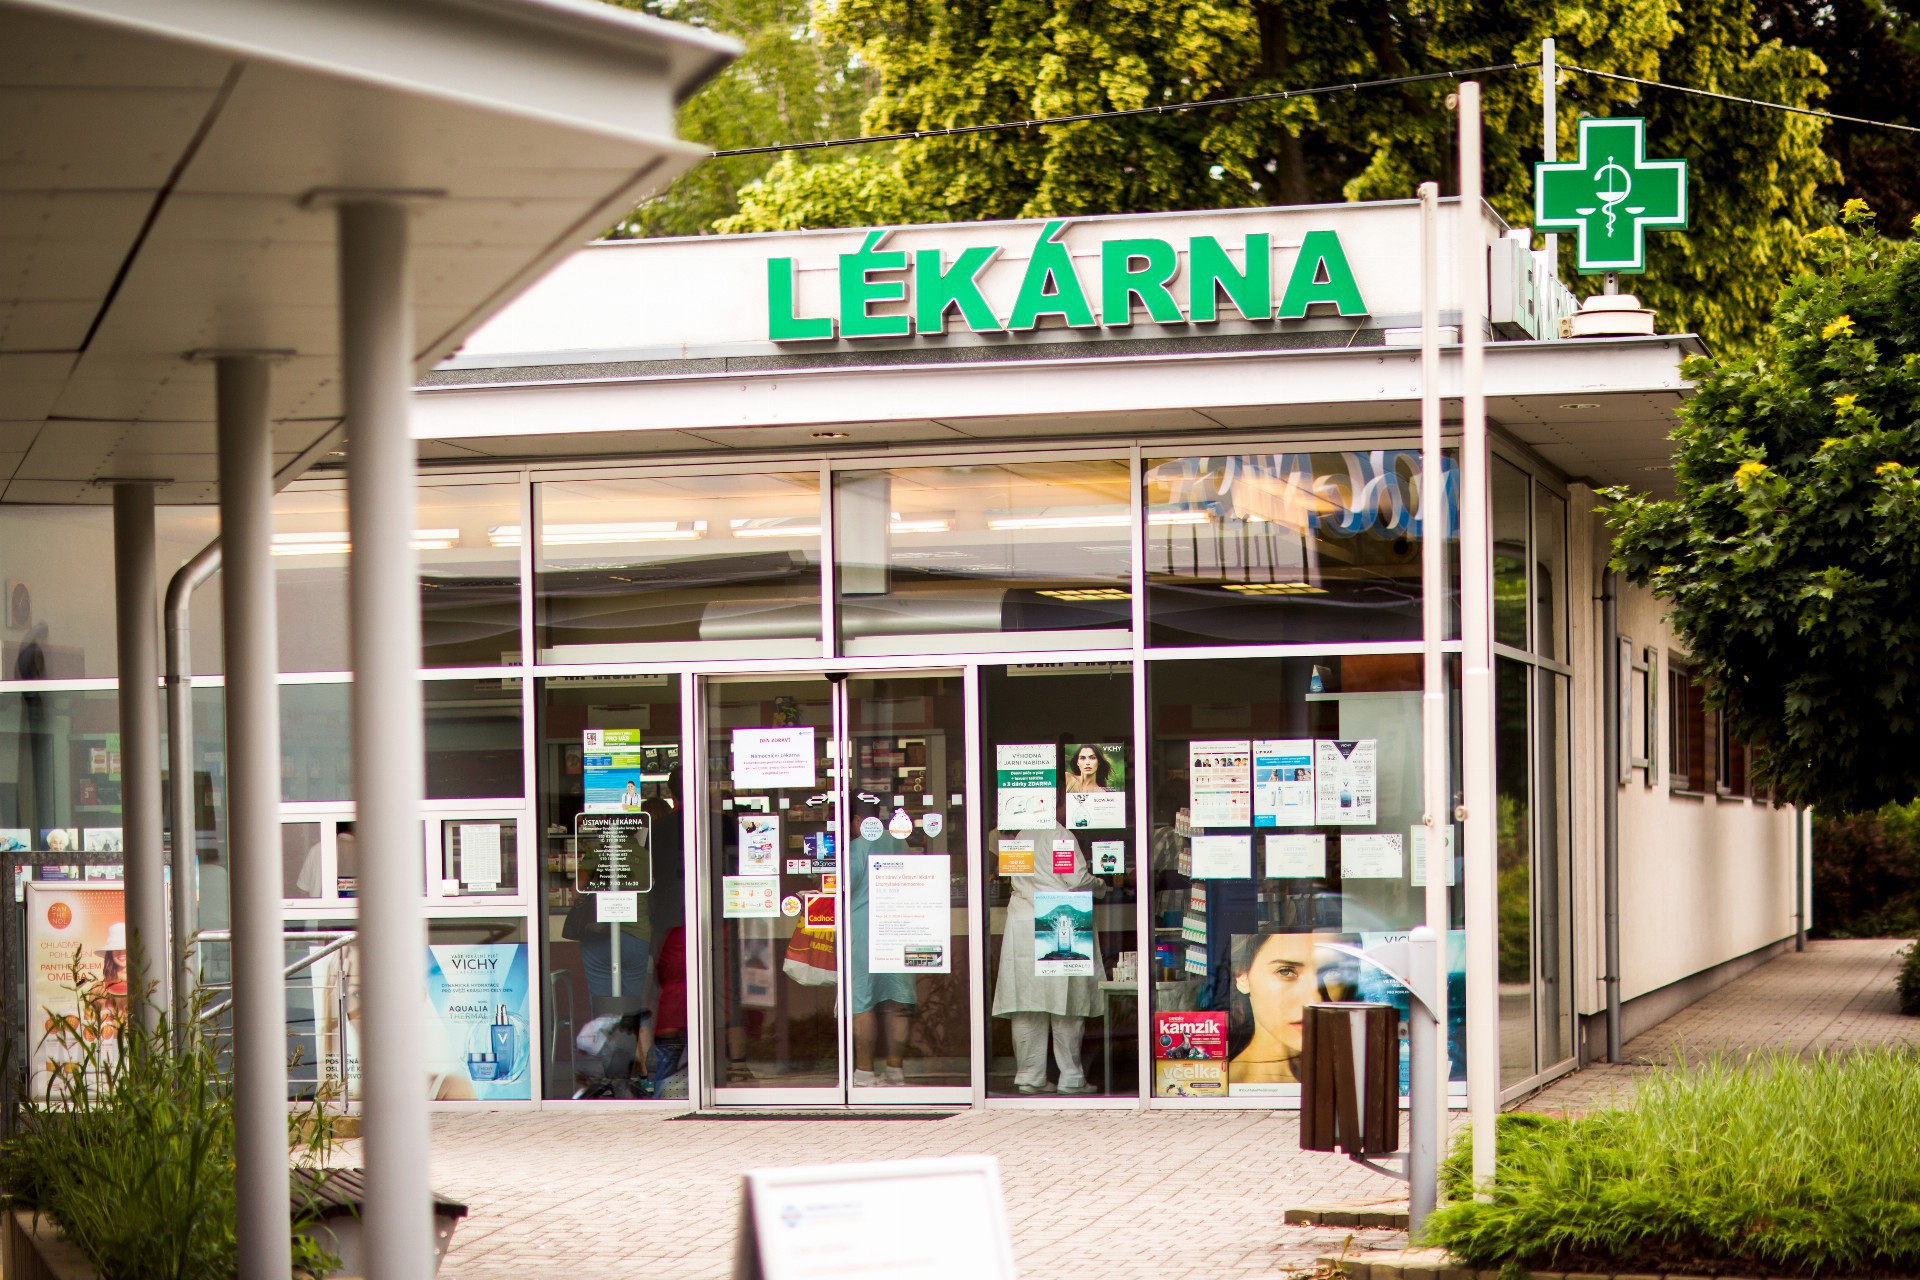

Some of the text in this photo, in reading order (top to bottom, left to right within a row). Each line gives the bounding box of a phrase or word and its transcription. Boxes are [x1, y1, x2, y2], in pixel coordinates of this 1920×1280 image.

[767, 220, 1371, 341] LÉKÁRNA
[582, 817, 643, 826] ÚSTAVNÍ LÉKÁRNA
[810, 941, 833, 953] MARKE
[50, 950, 93, 959] POHLAENÍ
[40, 963, 102, 971] PANTHEOLEM
[451, 958, 498, 970] VICHY
[1159, 1019, 1220, 1035] kamzík
[497, 1033, 508, 1045] V
[1163, 1062, 1221, 1080] včelka
